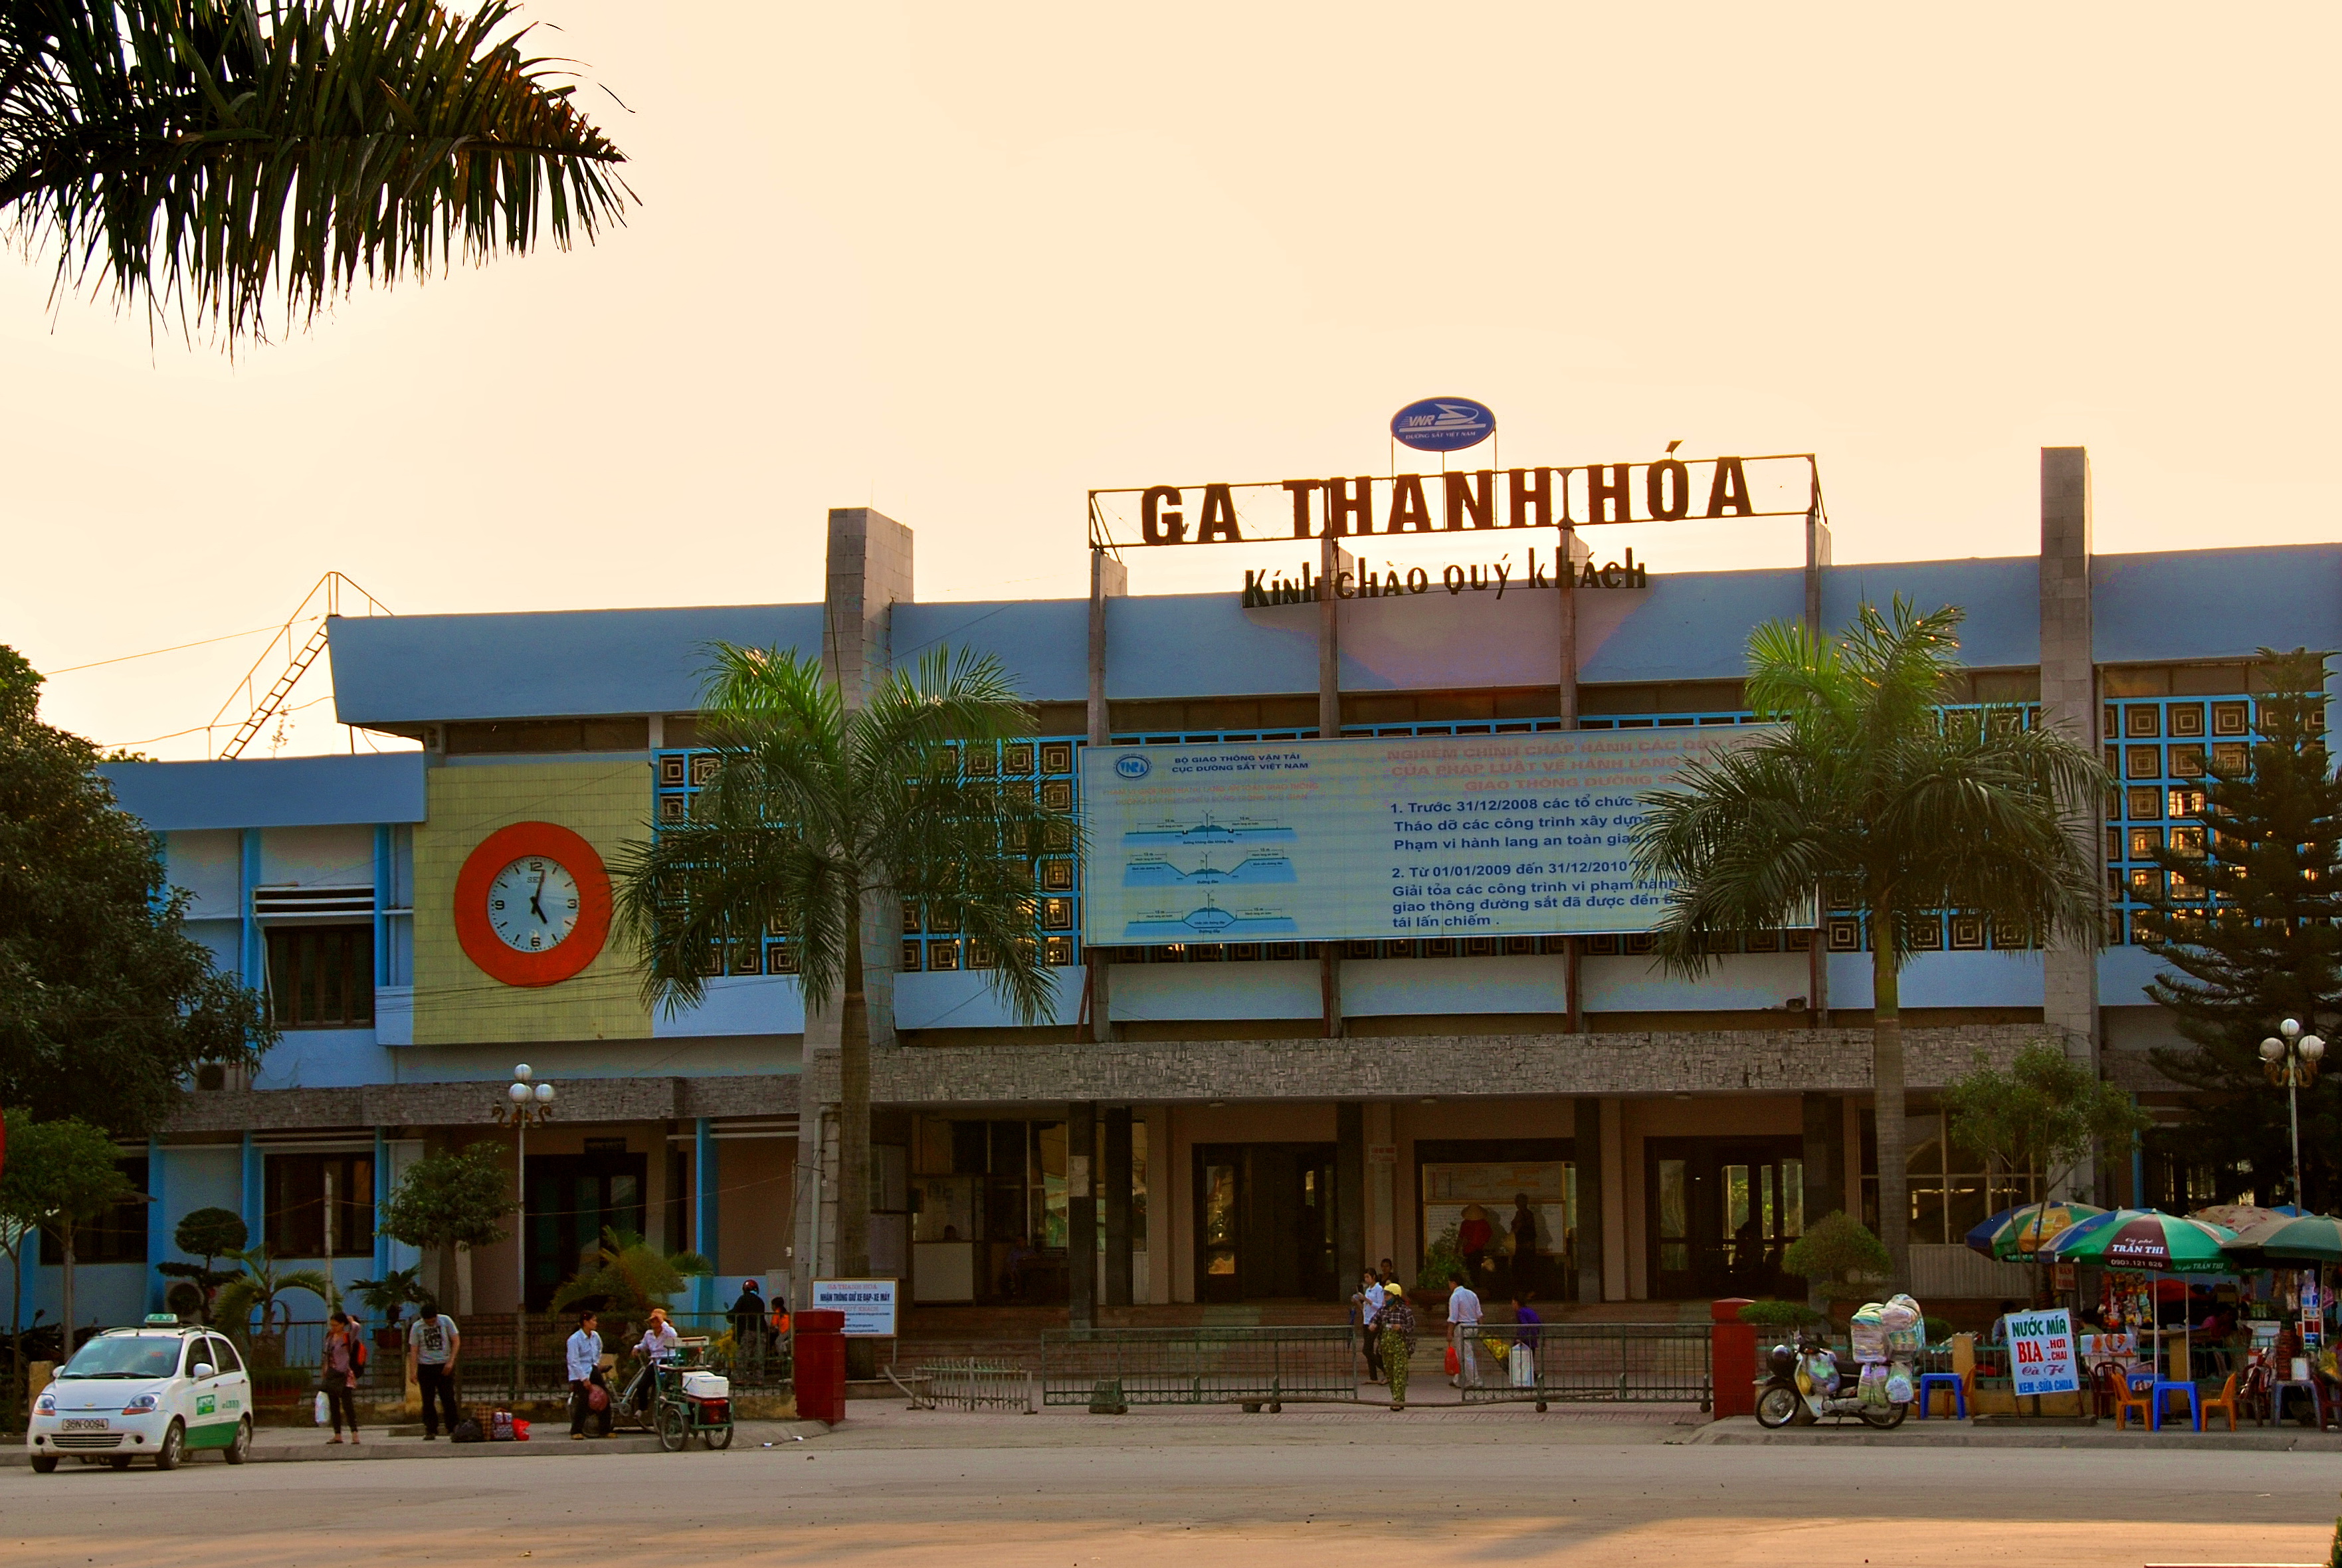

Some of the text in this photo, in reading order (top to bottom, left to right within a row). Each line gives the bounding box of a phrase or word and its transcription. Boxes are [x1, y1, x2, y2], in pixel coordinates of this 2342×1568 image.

[1408, 415, 1435, 427] VNR
[1140, 440, 1753, 546] GA THANH HÓA
[1236, 762, 1256, 771] SẮT
[1391, 803, 1403, 813] 1.
[1408, 801, 1452, 813] Trước
[1456, 799, 1538, 811] 31/12/2008
[1543, 798, 1570, 809] các
[1575, 793, 1591, 807] tổ
[1595, 794, 1633, 807] chức
[1394, 820, 1432, 832] Tháo
[1438, 819, 1458, 831] dỡ
[1462, 818, 1489, 830] các
[1494, 817, 1534, 831] công
[1539, 816, 1575, 828] trình
[1580, 815, 1608, 828] xây
[1394, 840, 1438, 852] Phạm
[1442, 838, 1456, 849] vi
[1461, 836, 1500, 849] hành
[1505, 836, 1539, 848] lang
[1543, 836, 1562, 846] an
[1567, 834, 1602, 846] toàn
[1607, 833, 1640, 846] giao
[530, 862, 543, 872] 12
[1392, 868, 1405, 878] 2.
[1409, 866, 1429, 878] Từ
[1432, 864, 1512, 877] 01/01/2009
[1515, 862, 1543, 875] đến
[1548, 861, 1627, 874] 31/12/2010
[1392, 878, 1678, 897] Giải tỏa các công trình vi phạm hành
[494, 899, 505, 910] 9
[567, 898, 577, 909] 3
[1393, 903, 1426, 914] giao
[1430, 901, 1474, 913] thông
[1480, 898, 1529, 911] đường
[1534, 896, 1558, 908] sắt
[1563, 896, 1581, 908] đã
[1586, 896, 1624, 909] được
[1630, 893, 1659, 906] đền
[1393, 912, 1491, 928] tái lấn chiếm
[531, 937, 541, 947] 6
[2145, 1246, 2164, 1254] THI
[2011, 1314, 2067, 1337] NƯỚC MÍA
[2016, 1341, 2044, 1363] BIA
[2018, 1382, 2034, 1393] KEM
[2054, 1379, 2075, 1391] CHUA
